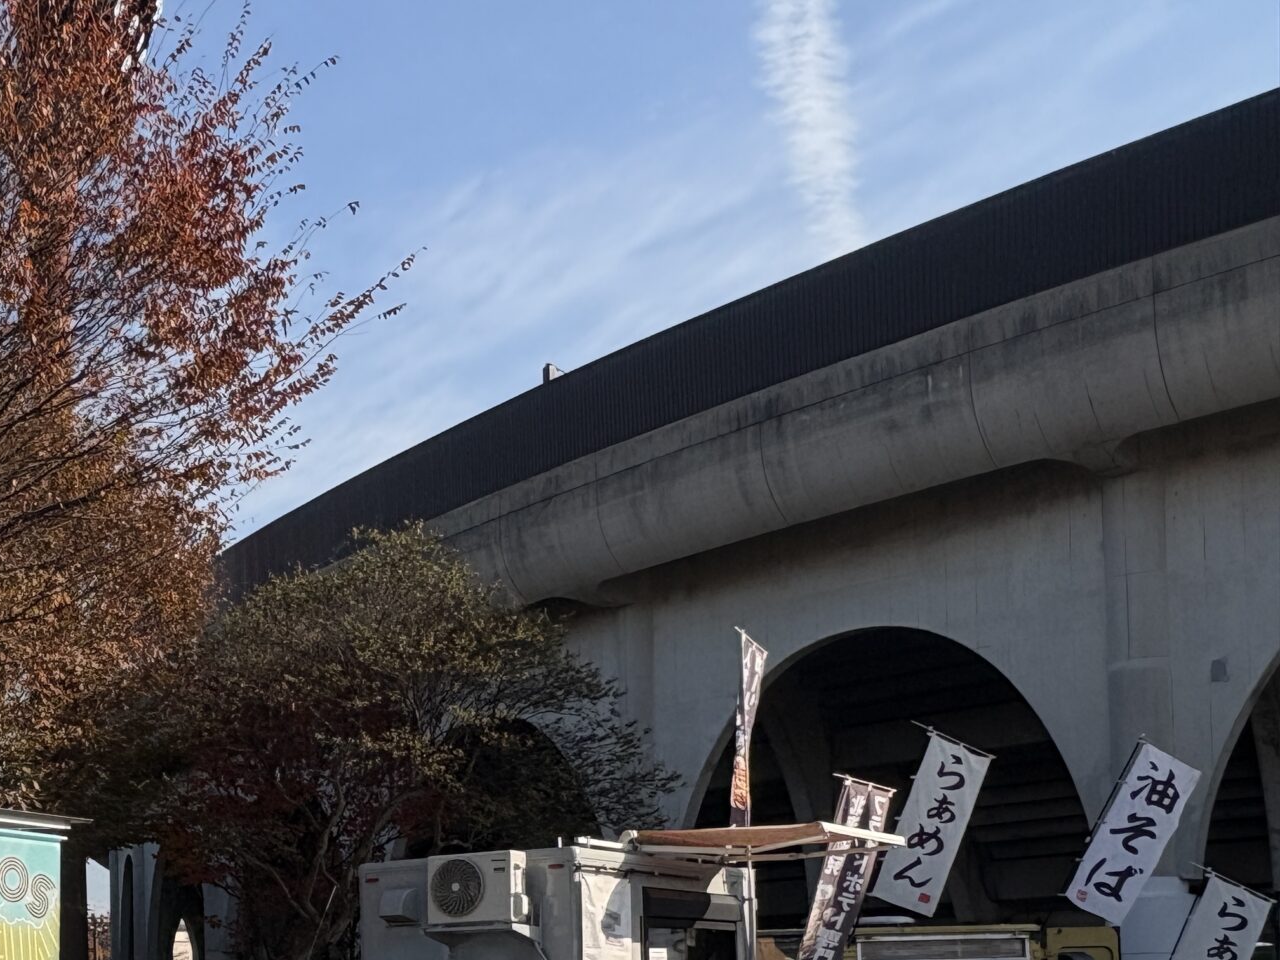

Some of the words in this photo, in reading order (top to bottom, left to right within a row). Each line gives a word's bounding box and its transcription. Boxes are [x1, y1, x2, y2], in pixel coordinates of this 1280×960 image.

[892, 753, 966, 890] らぁめん
[1083, 760, 1180, 902] 油そば
